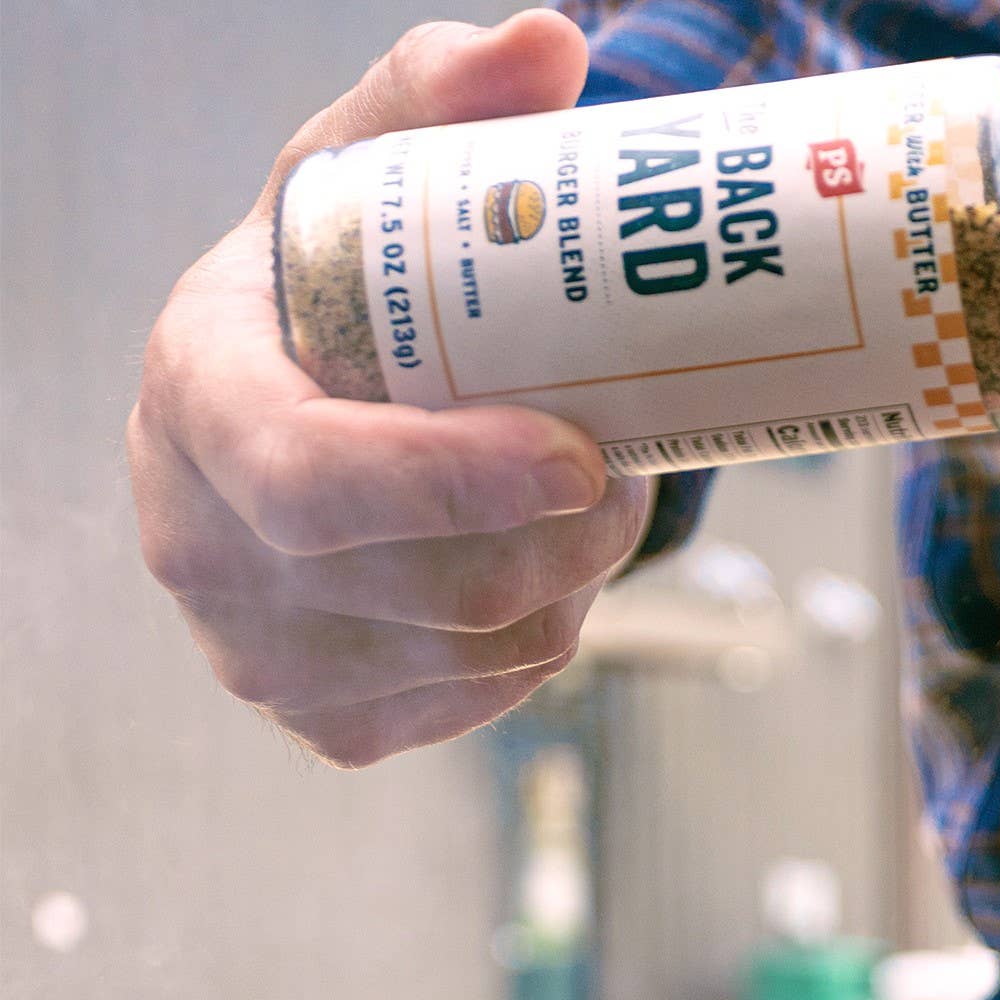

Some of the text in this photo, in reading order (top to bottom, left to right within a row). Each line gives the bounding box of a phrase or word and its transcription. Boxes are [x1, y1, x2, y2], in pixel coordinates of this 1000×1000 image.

[382, 161, 406, 188] WT
[818, 147, 853, 188] PS
[381, 194, 406, 235] 7.5
[457, 199, 472, 244] SALT
[556, 130, 589, 304] BURGER BLEND
[616, 111, 710, 298] YARD
[715, 145, 785, 285] BACK
[383, 244, 406, 278] OZ
[906, 187, 939, 295] BUTTER
[459, 258, 482, 319] BUTTER
[383, 286, 423, 371] (213g)
